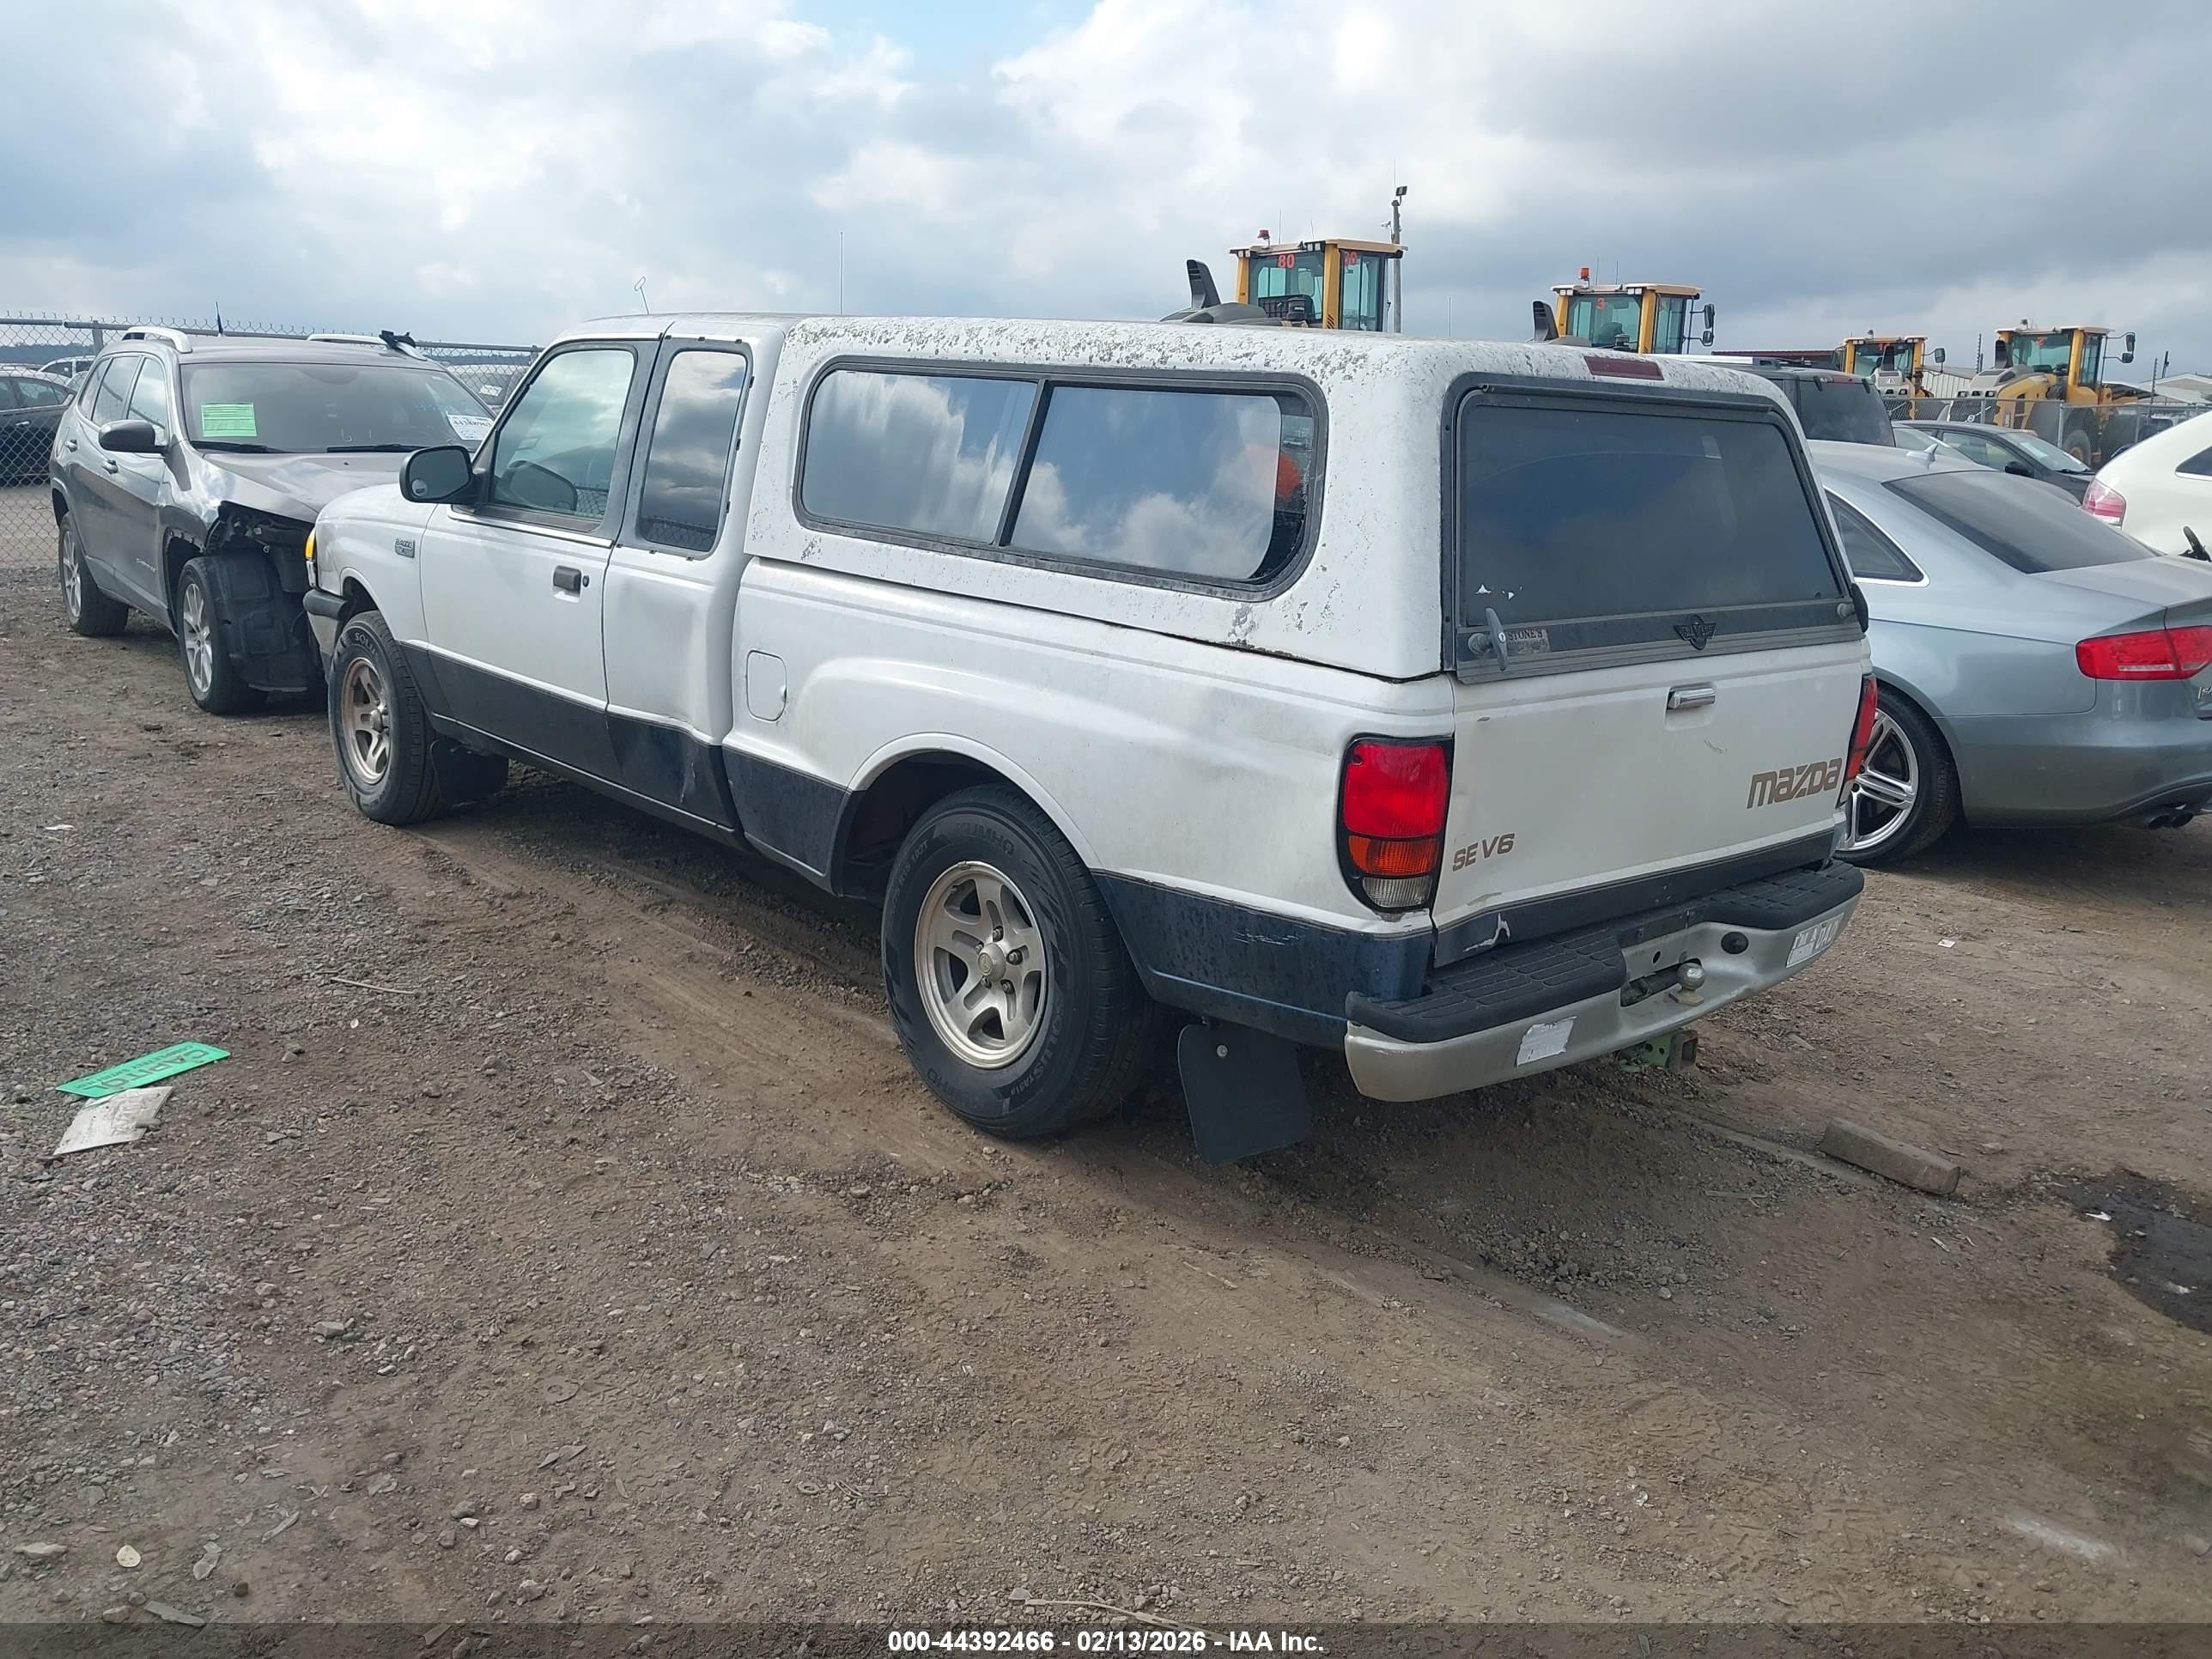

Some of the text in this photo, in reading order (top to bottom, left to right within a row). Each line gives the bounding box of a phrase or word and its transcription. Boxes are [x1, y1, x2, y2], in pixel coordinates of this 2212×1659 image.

[1278, 253, 1295, 269] 80
[1508, 628, 1543, 641] STONE'S
[1452, 833, 1516, 872] SE V6
[82, 1049, 210, 1091] CAPITOL
